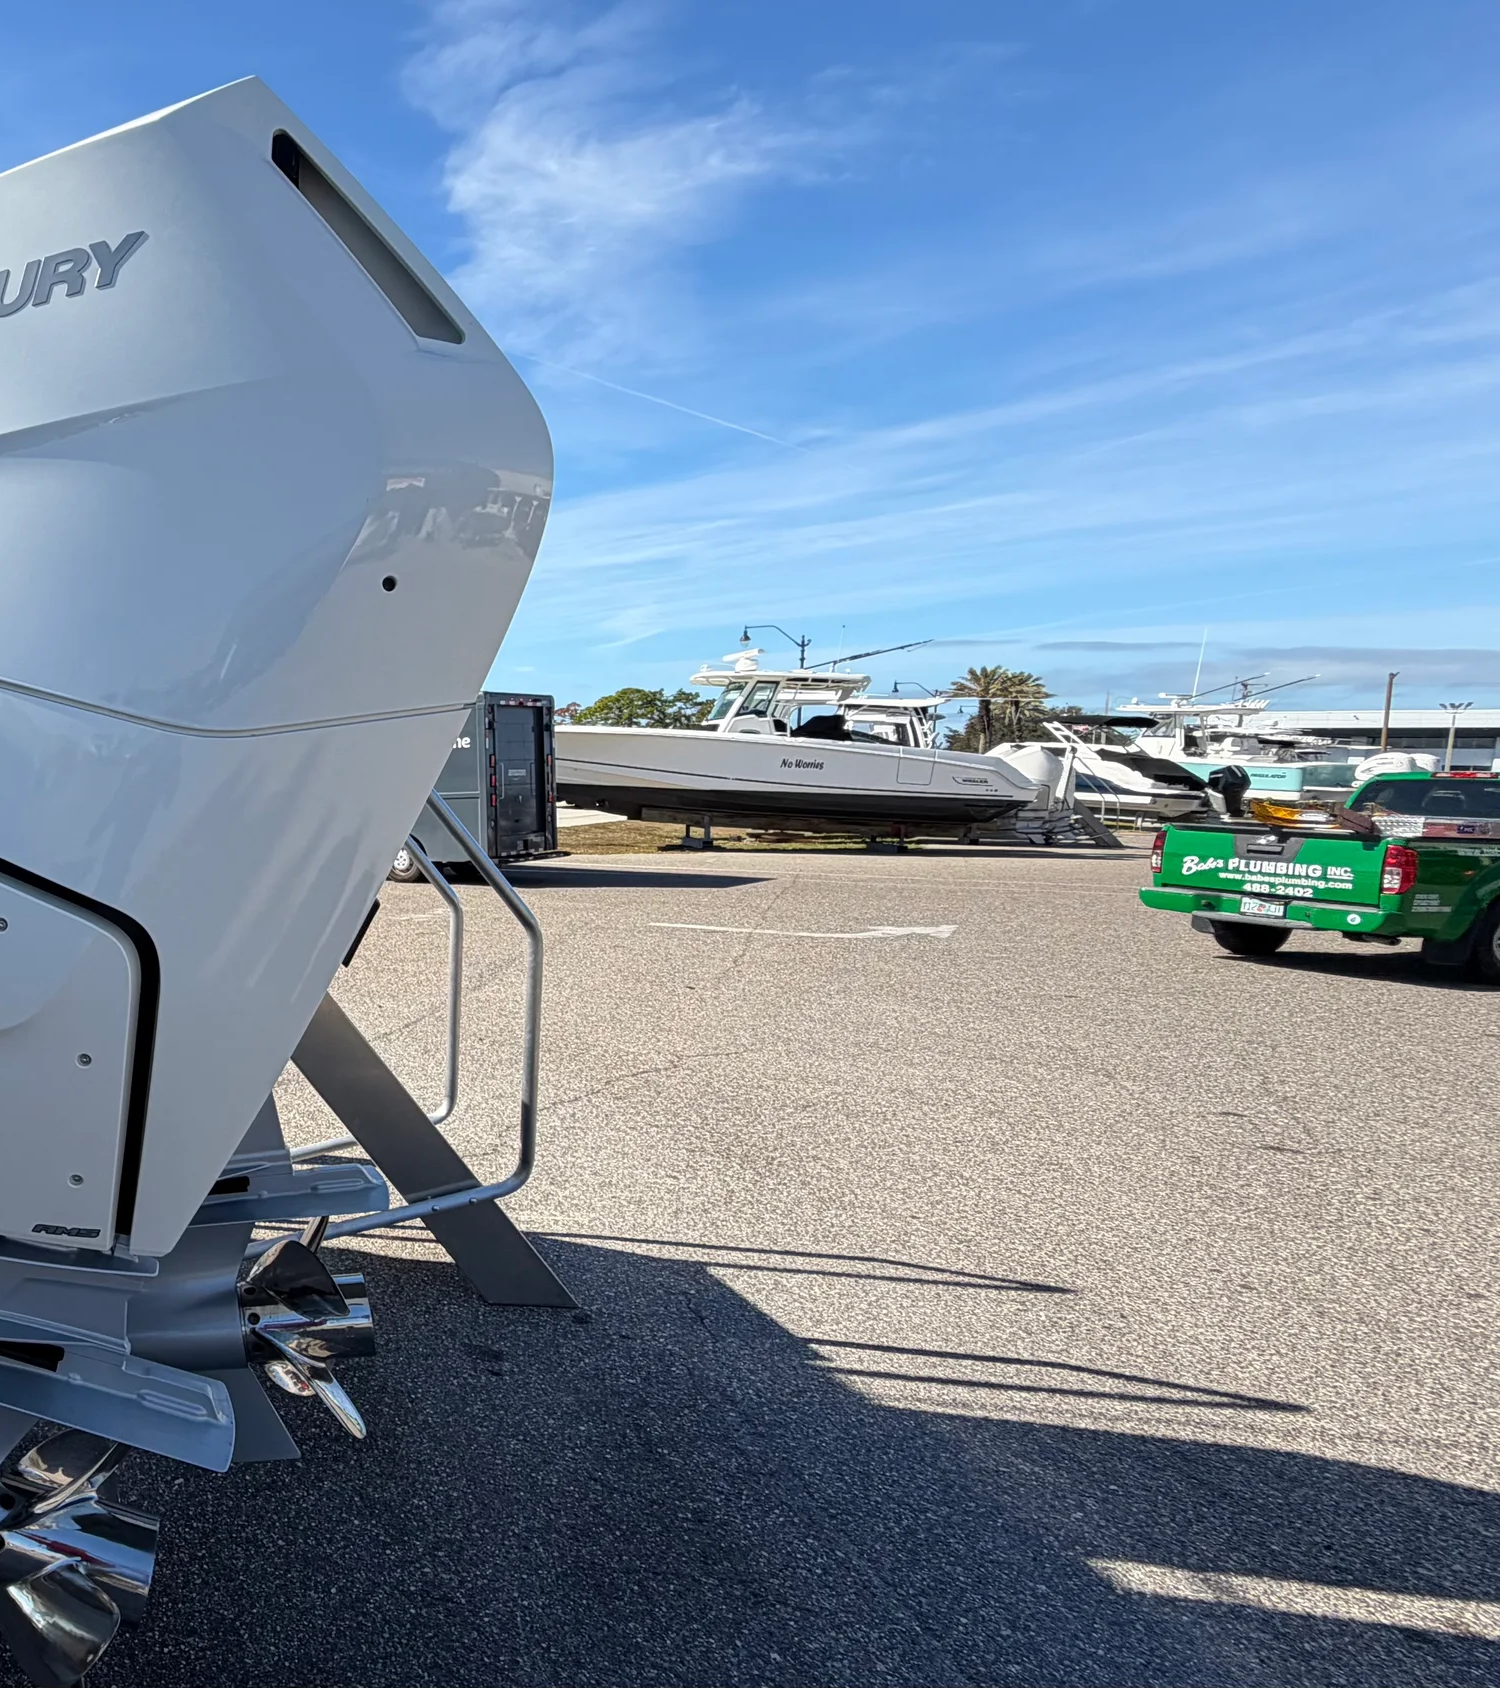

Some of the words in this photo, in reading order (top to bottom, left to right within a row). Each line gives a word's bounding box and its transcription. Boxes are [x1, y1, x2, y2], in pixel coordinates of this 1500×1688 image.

[780, 758, 794, 769] No
[795, 758, 825, 771] Worries
[1227, 857, 1323, 877] PLUMBING
[1218, 872, 1353, 890] www.babesplumbing.com
[1242, 882, 1314, 898] 488-2402
